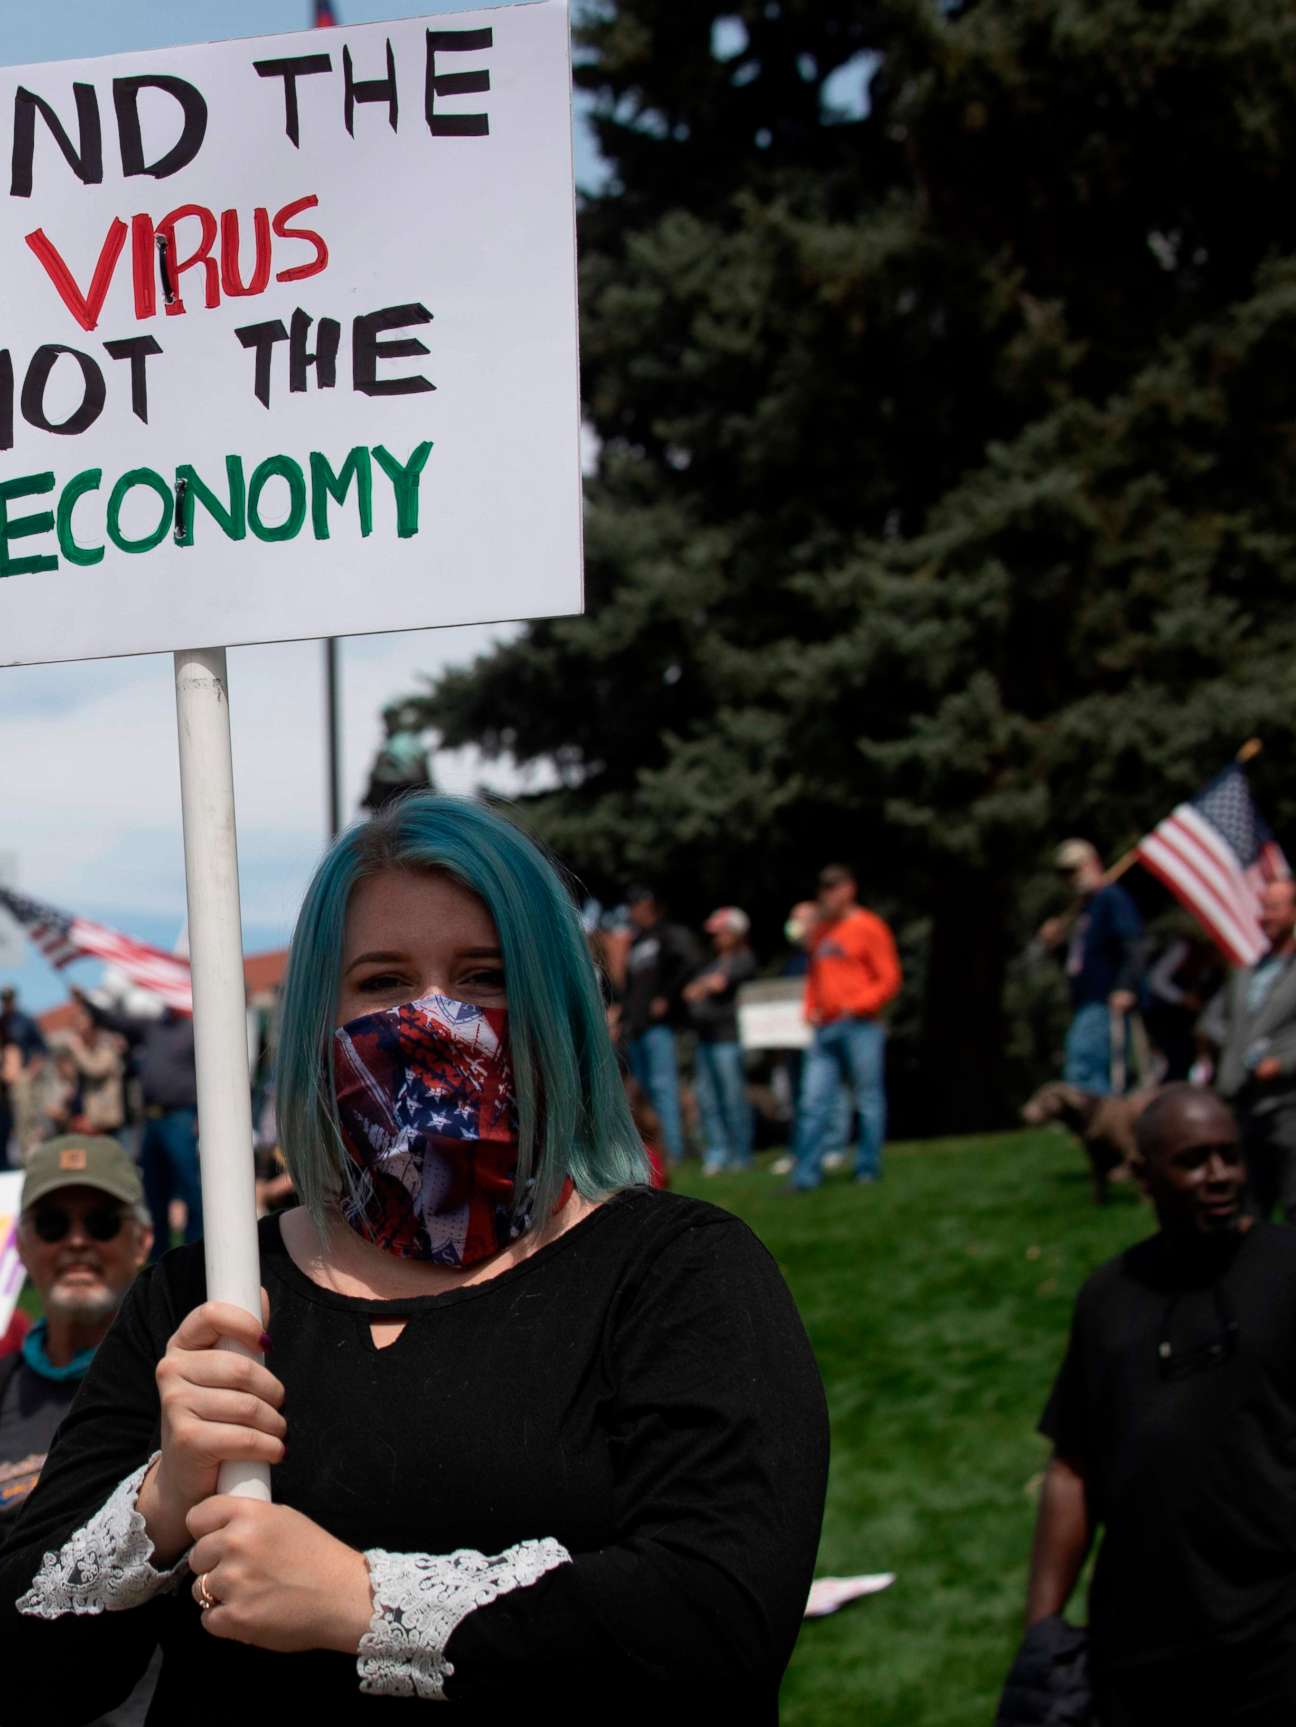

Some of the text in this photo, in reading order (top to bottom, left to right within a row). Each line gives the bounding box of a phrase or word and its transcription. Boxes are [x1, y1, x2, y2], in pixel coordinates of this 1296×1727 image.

[252, 26, 494, 150] THE
[25, 194, 330, 332] VIRUS
[234, 302, 438, 410] THE
